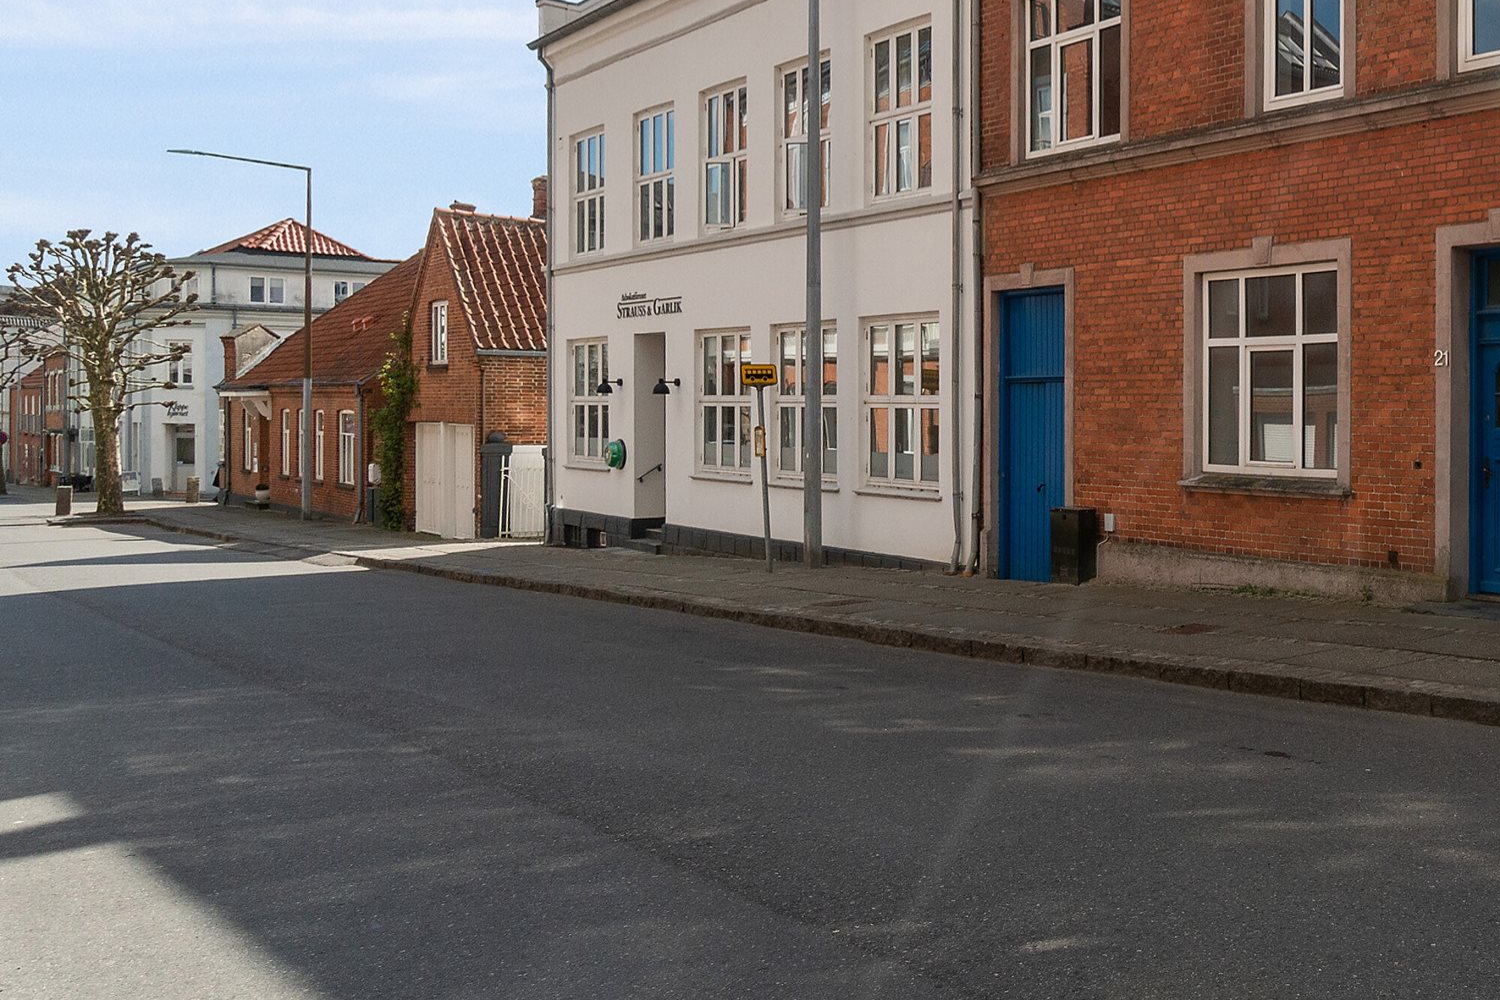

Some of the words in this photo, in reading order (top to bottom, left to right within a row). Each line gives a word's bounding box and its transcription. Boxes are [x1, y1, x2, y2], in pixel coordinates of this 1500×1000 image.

[617, 302, 646, 319] STRAUSS
[647, 306, 652, 316] &
[653, 298, 682, 315] GARLIK
[1434, 350, 1449, 367] 21
